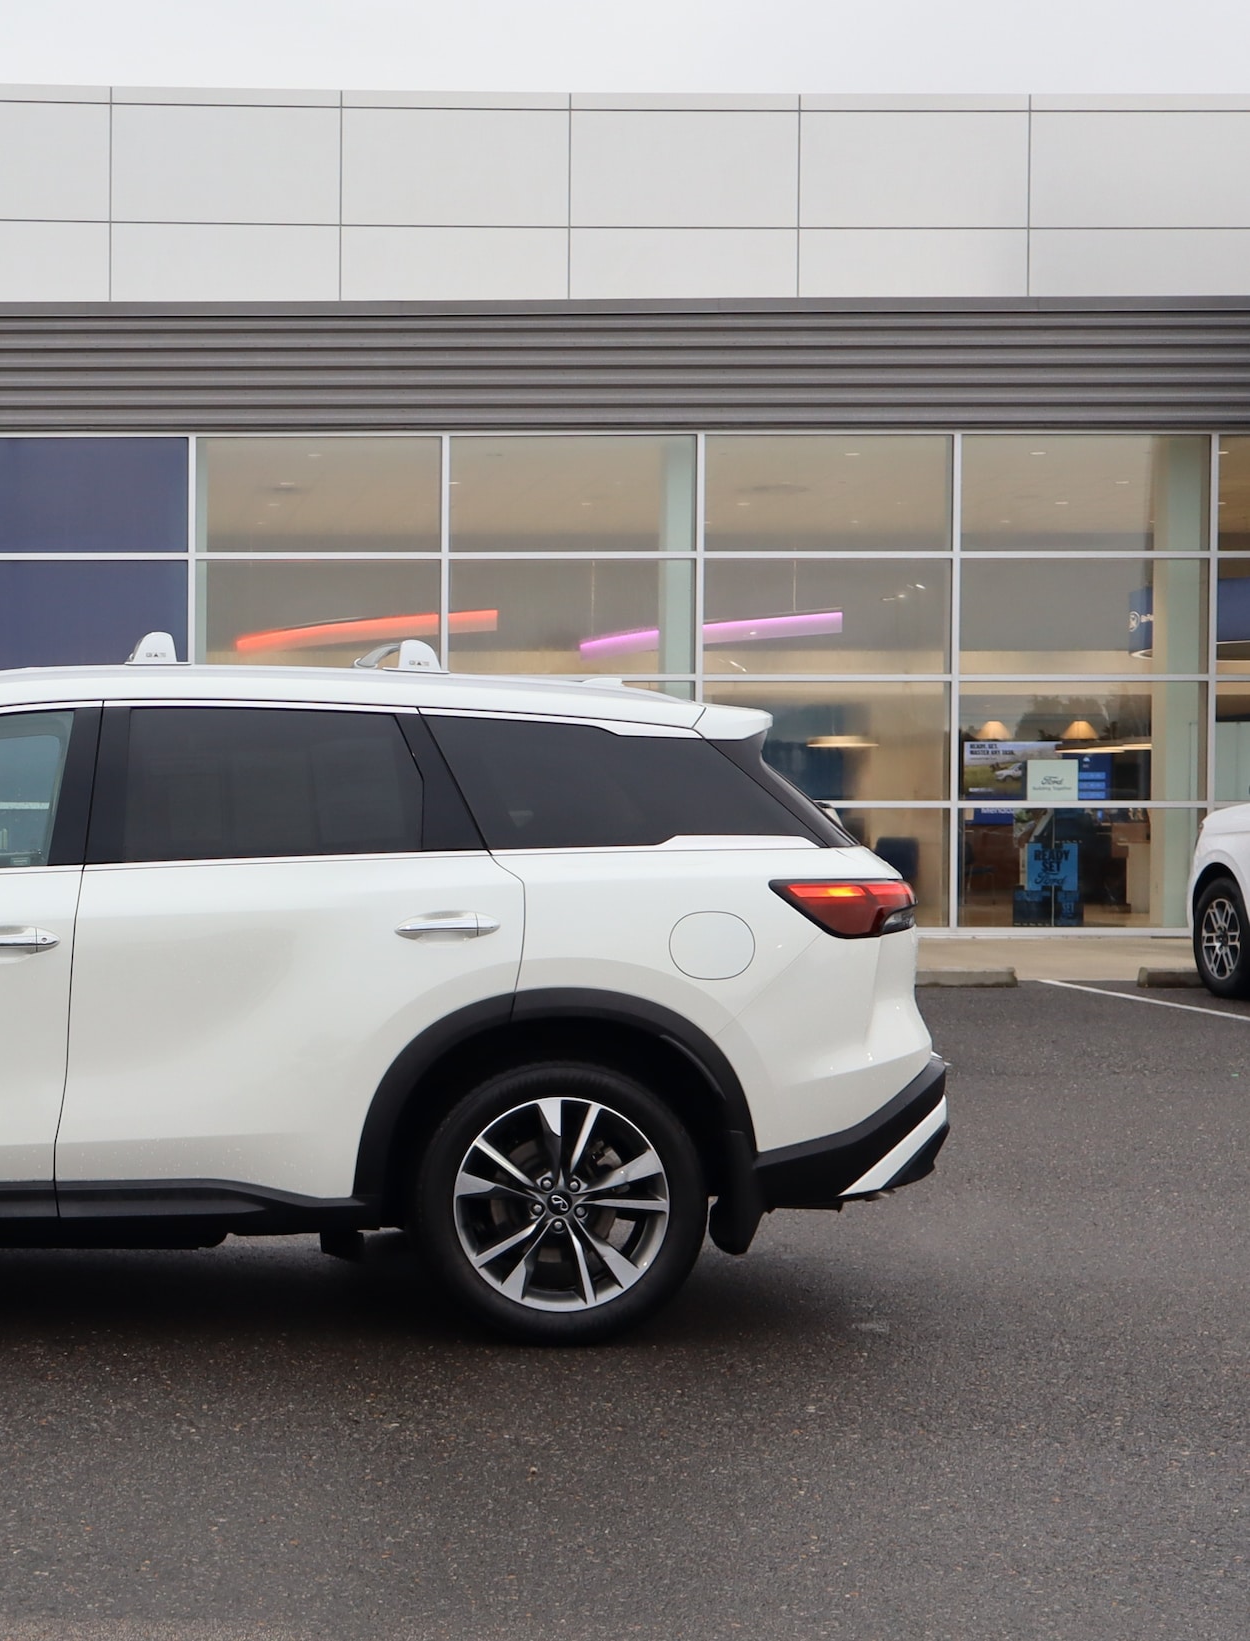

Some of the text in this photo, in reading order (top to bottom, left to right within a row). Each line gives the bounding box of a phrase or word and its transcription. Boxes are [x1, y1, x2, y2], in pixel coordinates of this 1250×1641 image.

[1041, 775, 1065, 786] Ford
[1034, 850, 1070, 861] READY
[1041, 861, 1061, 873] SET
[1034, 872, 1068, 885] Ford
